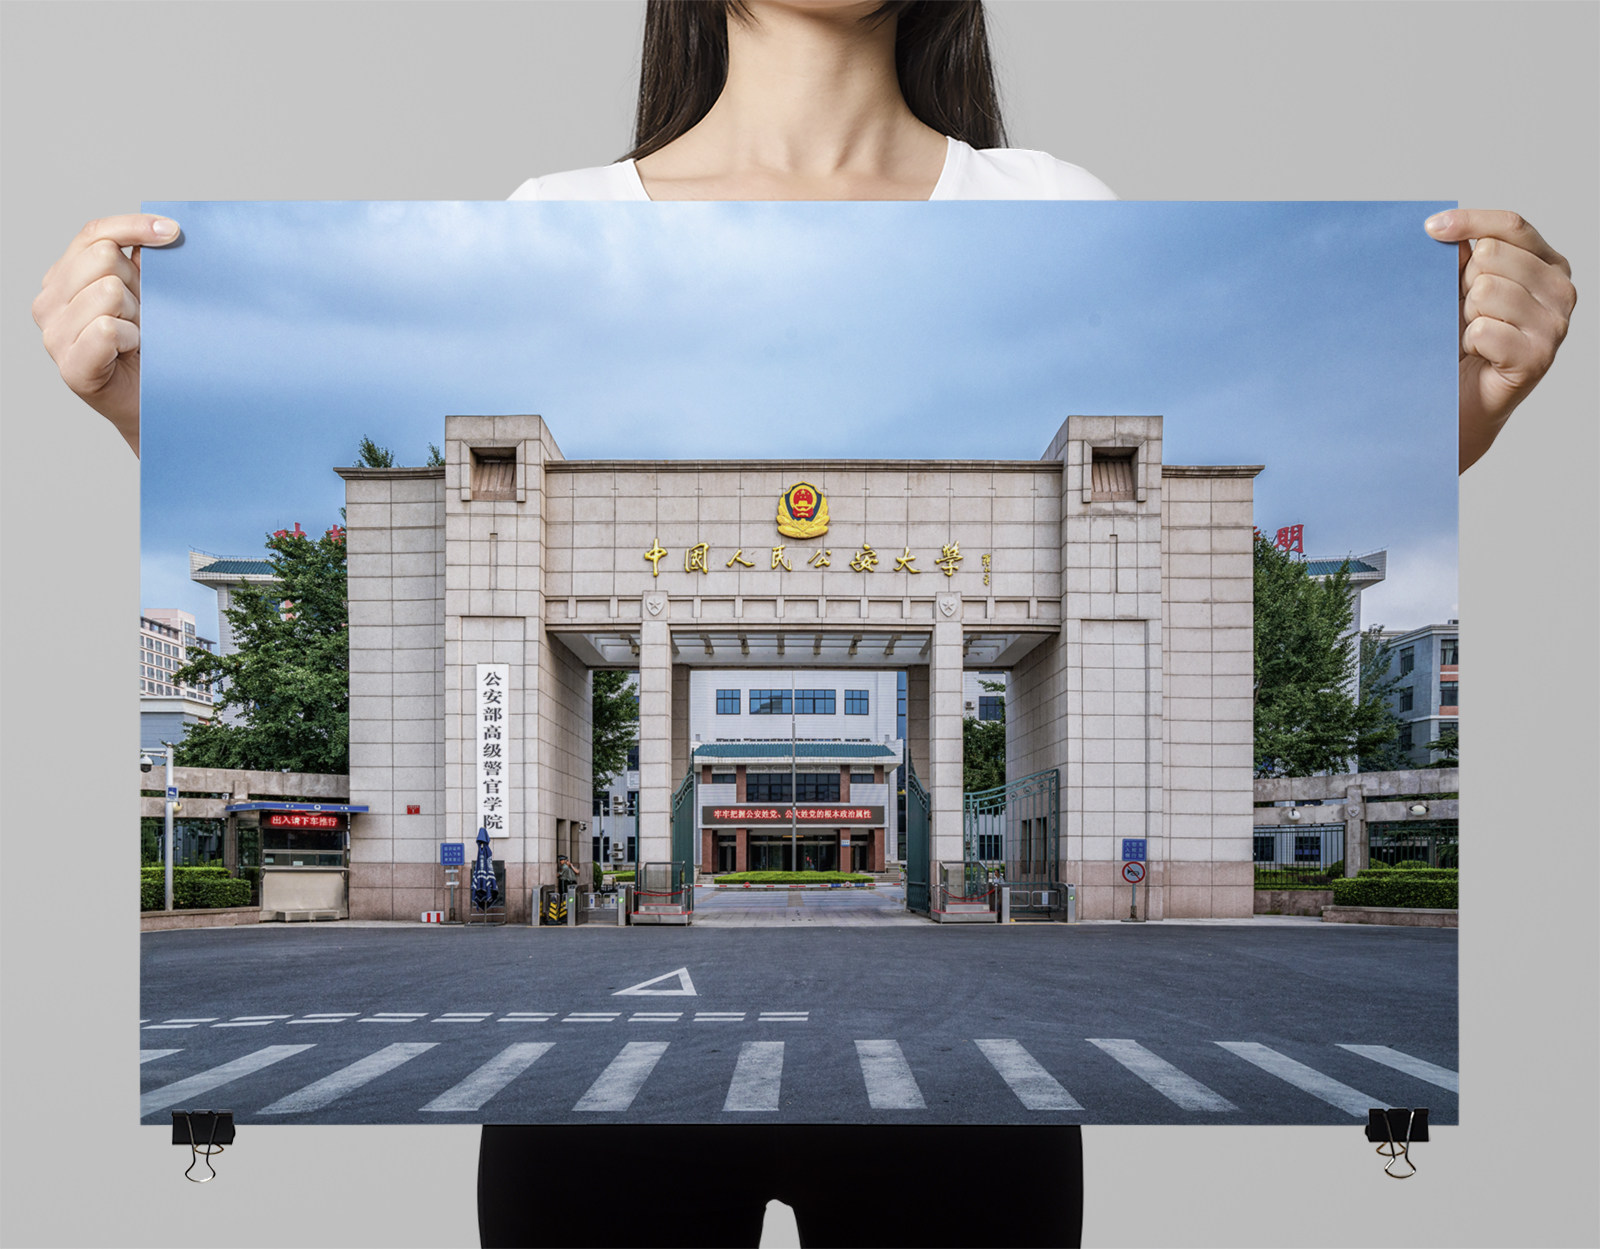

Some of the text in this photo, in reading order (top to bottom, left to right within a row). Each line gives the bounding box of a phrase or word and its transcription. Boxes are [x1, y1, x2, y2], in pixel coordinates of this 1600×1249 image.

[482, 671, 503, 830] 公安部高级警官学院
[271, 815, 337, 827] 出入请下车推行
